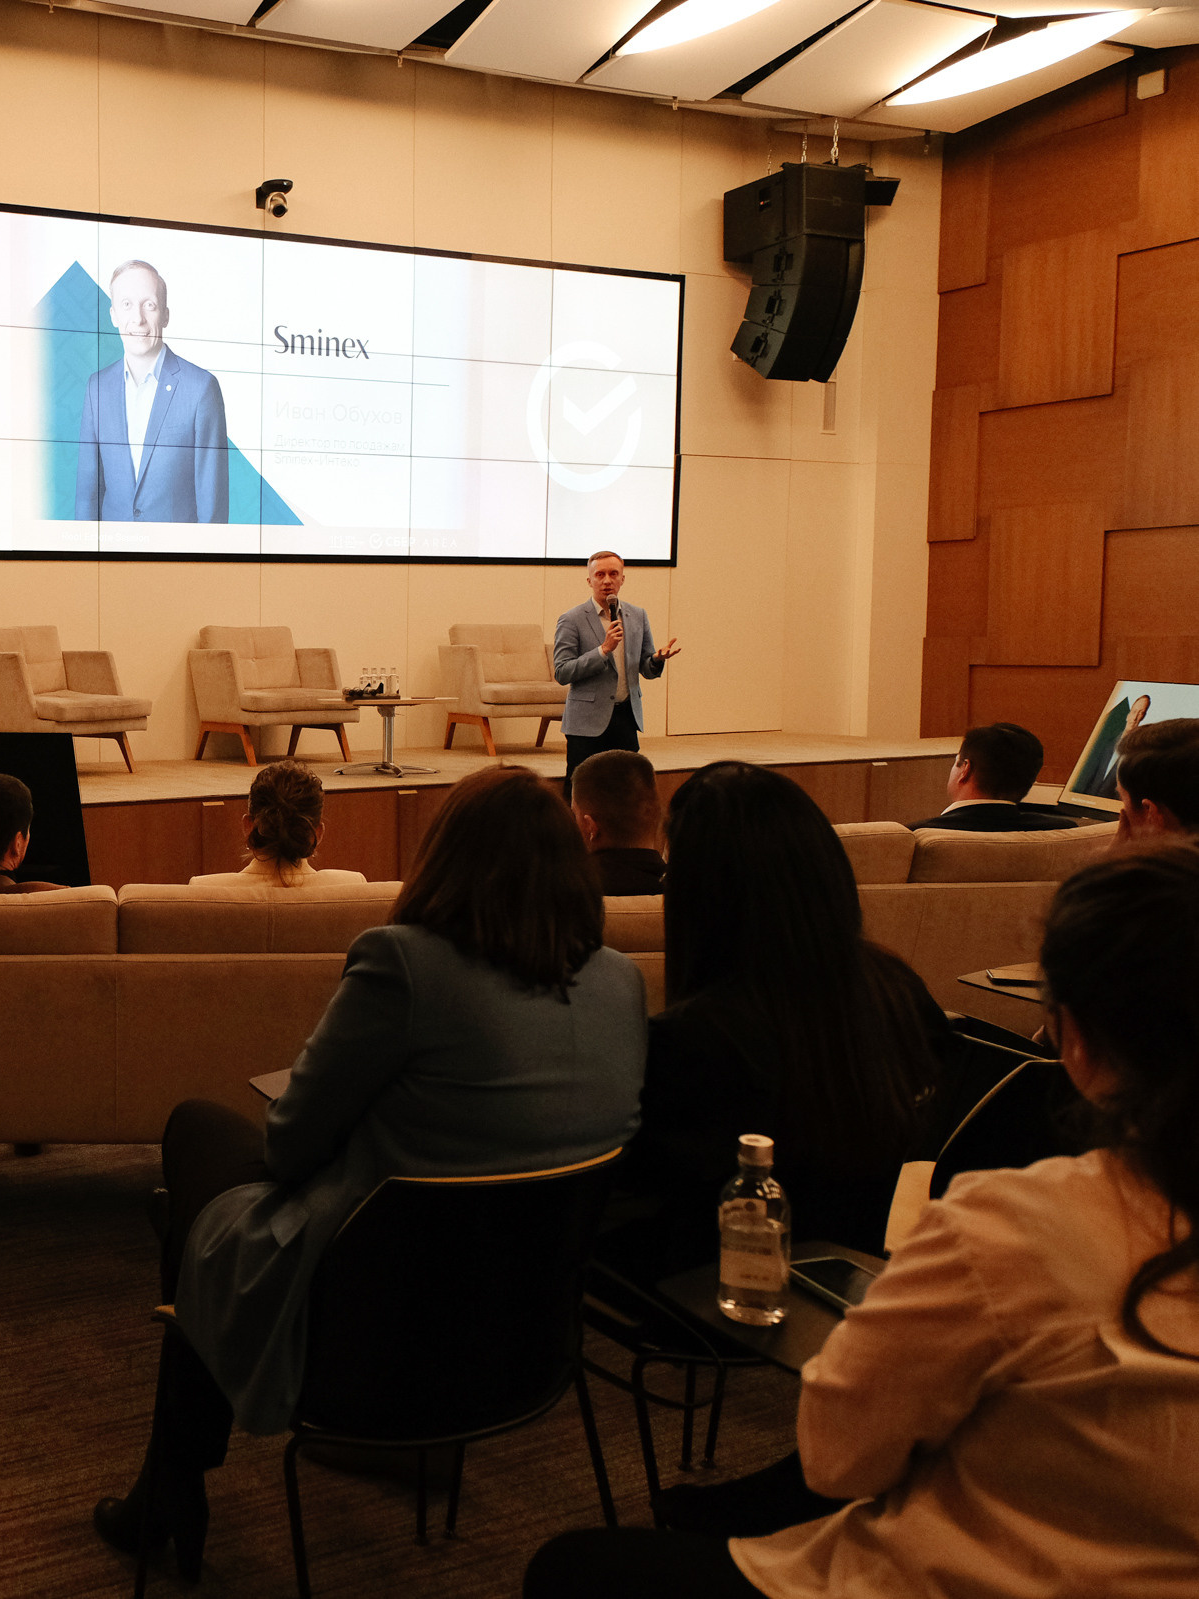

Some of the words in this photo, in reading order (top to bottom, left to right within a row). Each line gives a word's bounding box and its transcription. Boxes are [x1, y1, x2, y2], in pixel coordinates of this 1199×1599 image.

[274, 325, 369, 359] Sminex
[275, 400, 325, 422] Иван
[332, 402, 403, 426] Обухов
